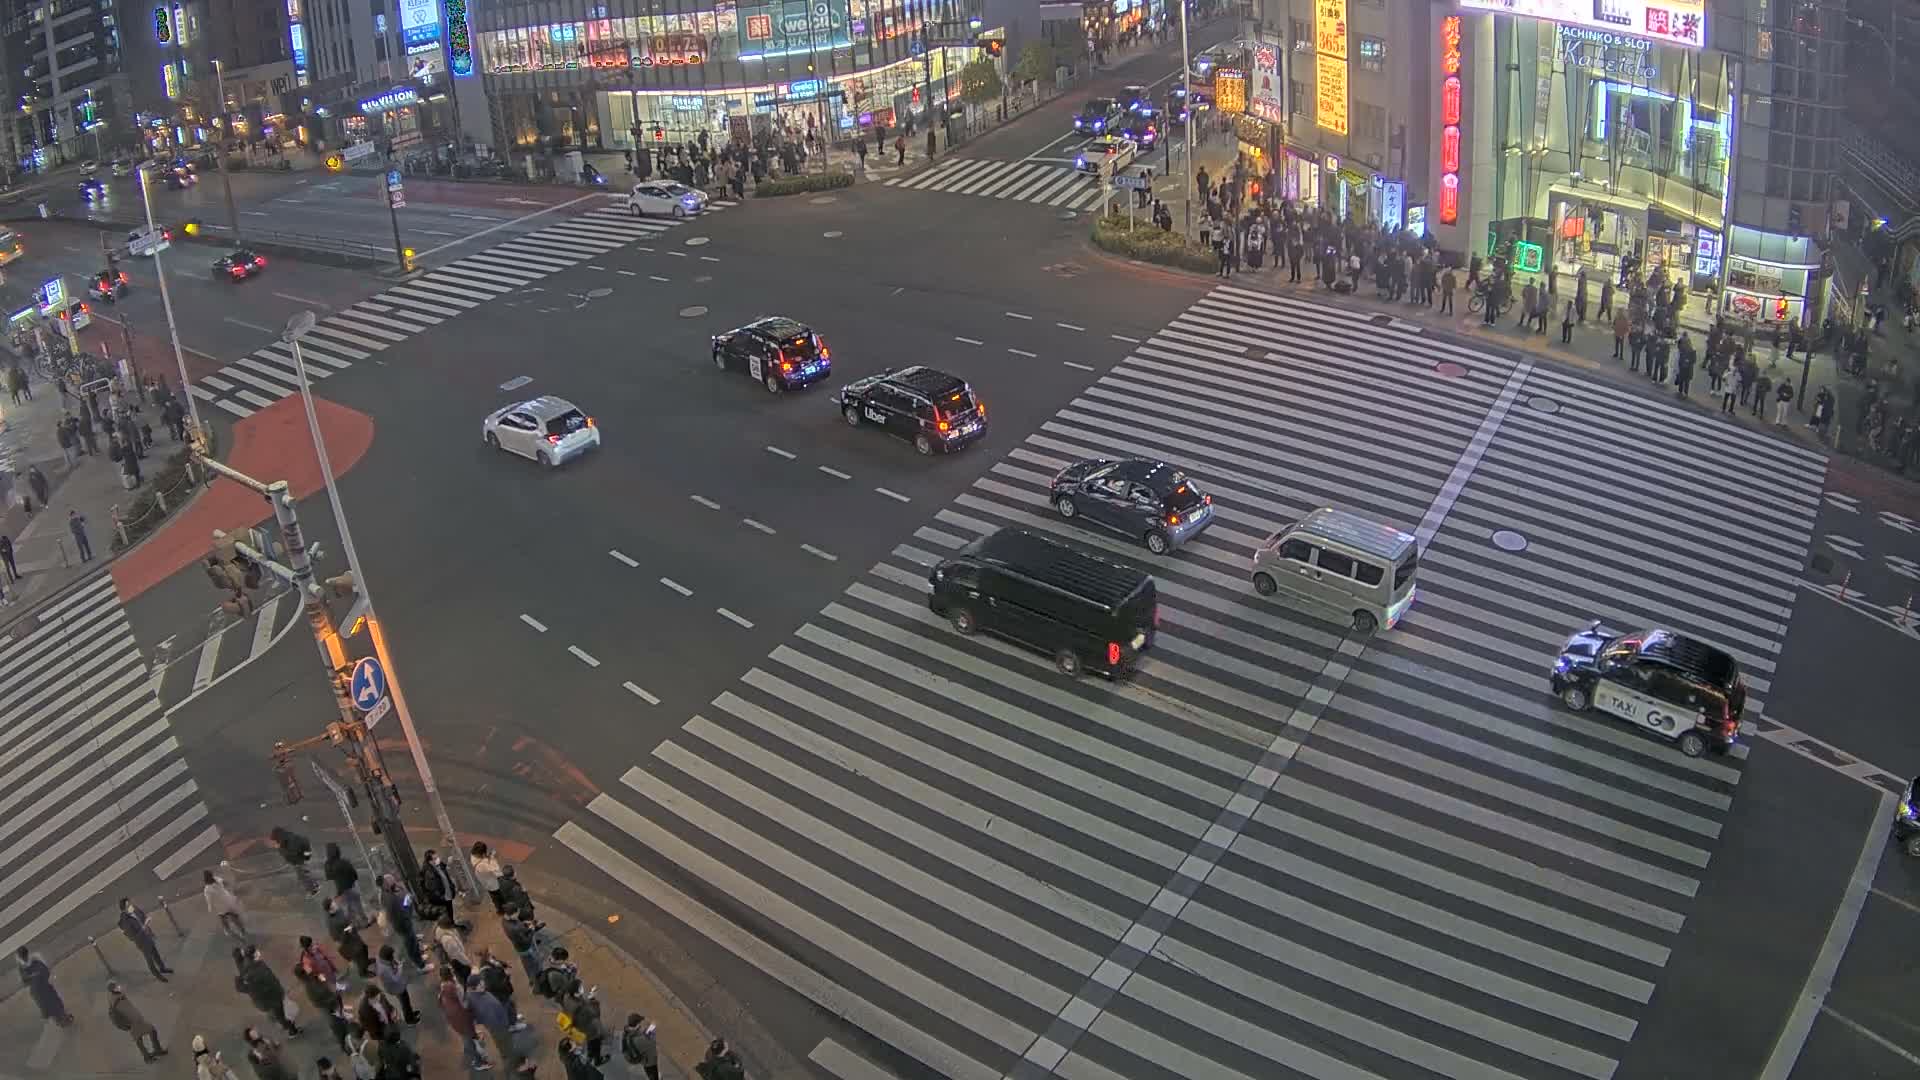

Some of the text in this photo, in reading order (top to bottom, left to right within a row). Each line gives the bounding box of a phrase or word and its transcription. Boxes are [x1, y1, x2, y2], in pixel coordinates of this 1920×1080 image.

[1557, 24, 1652, 51] PACHINKO & SLOT
[865, 407, 886, 425] Uber
[1611, 697, 1676, 732] TAXI GO
